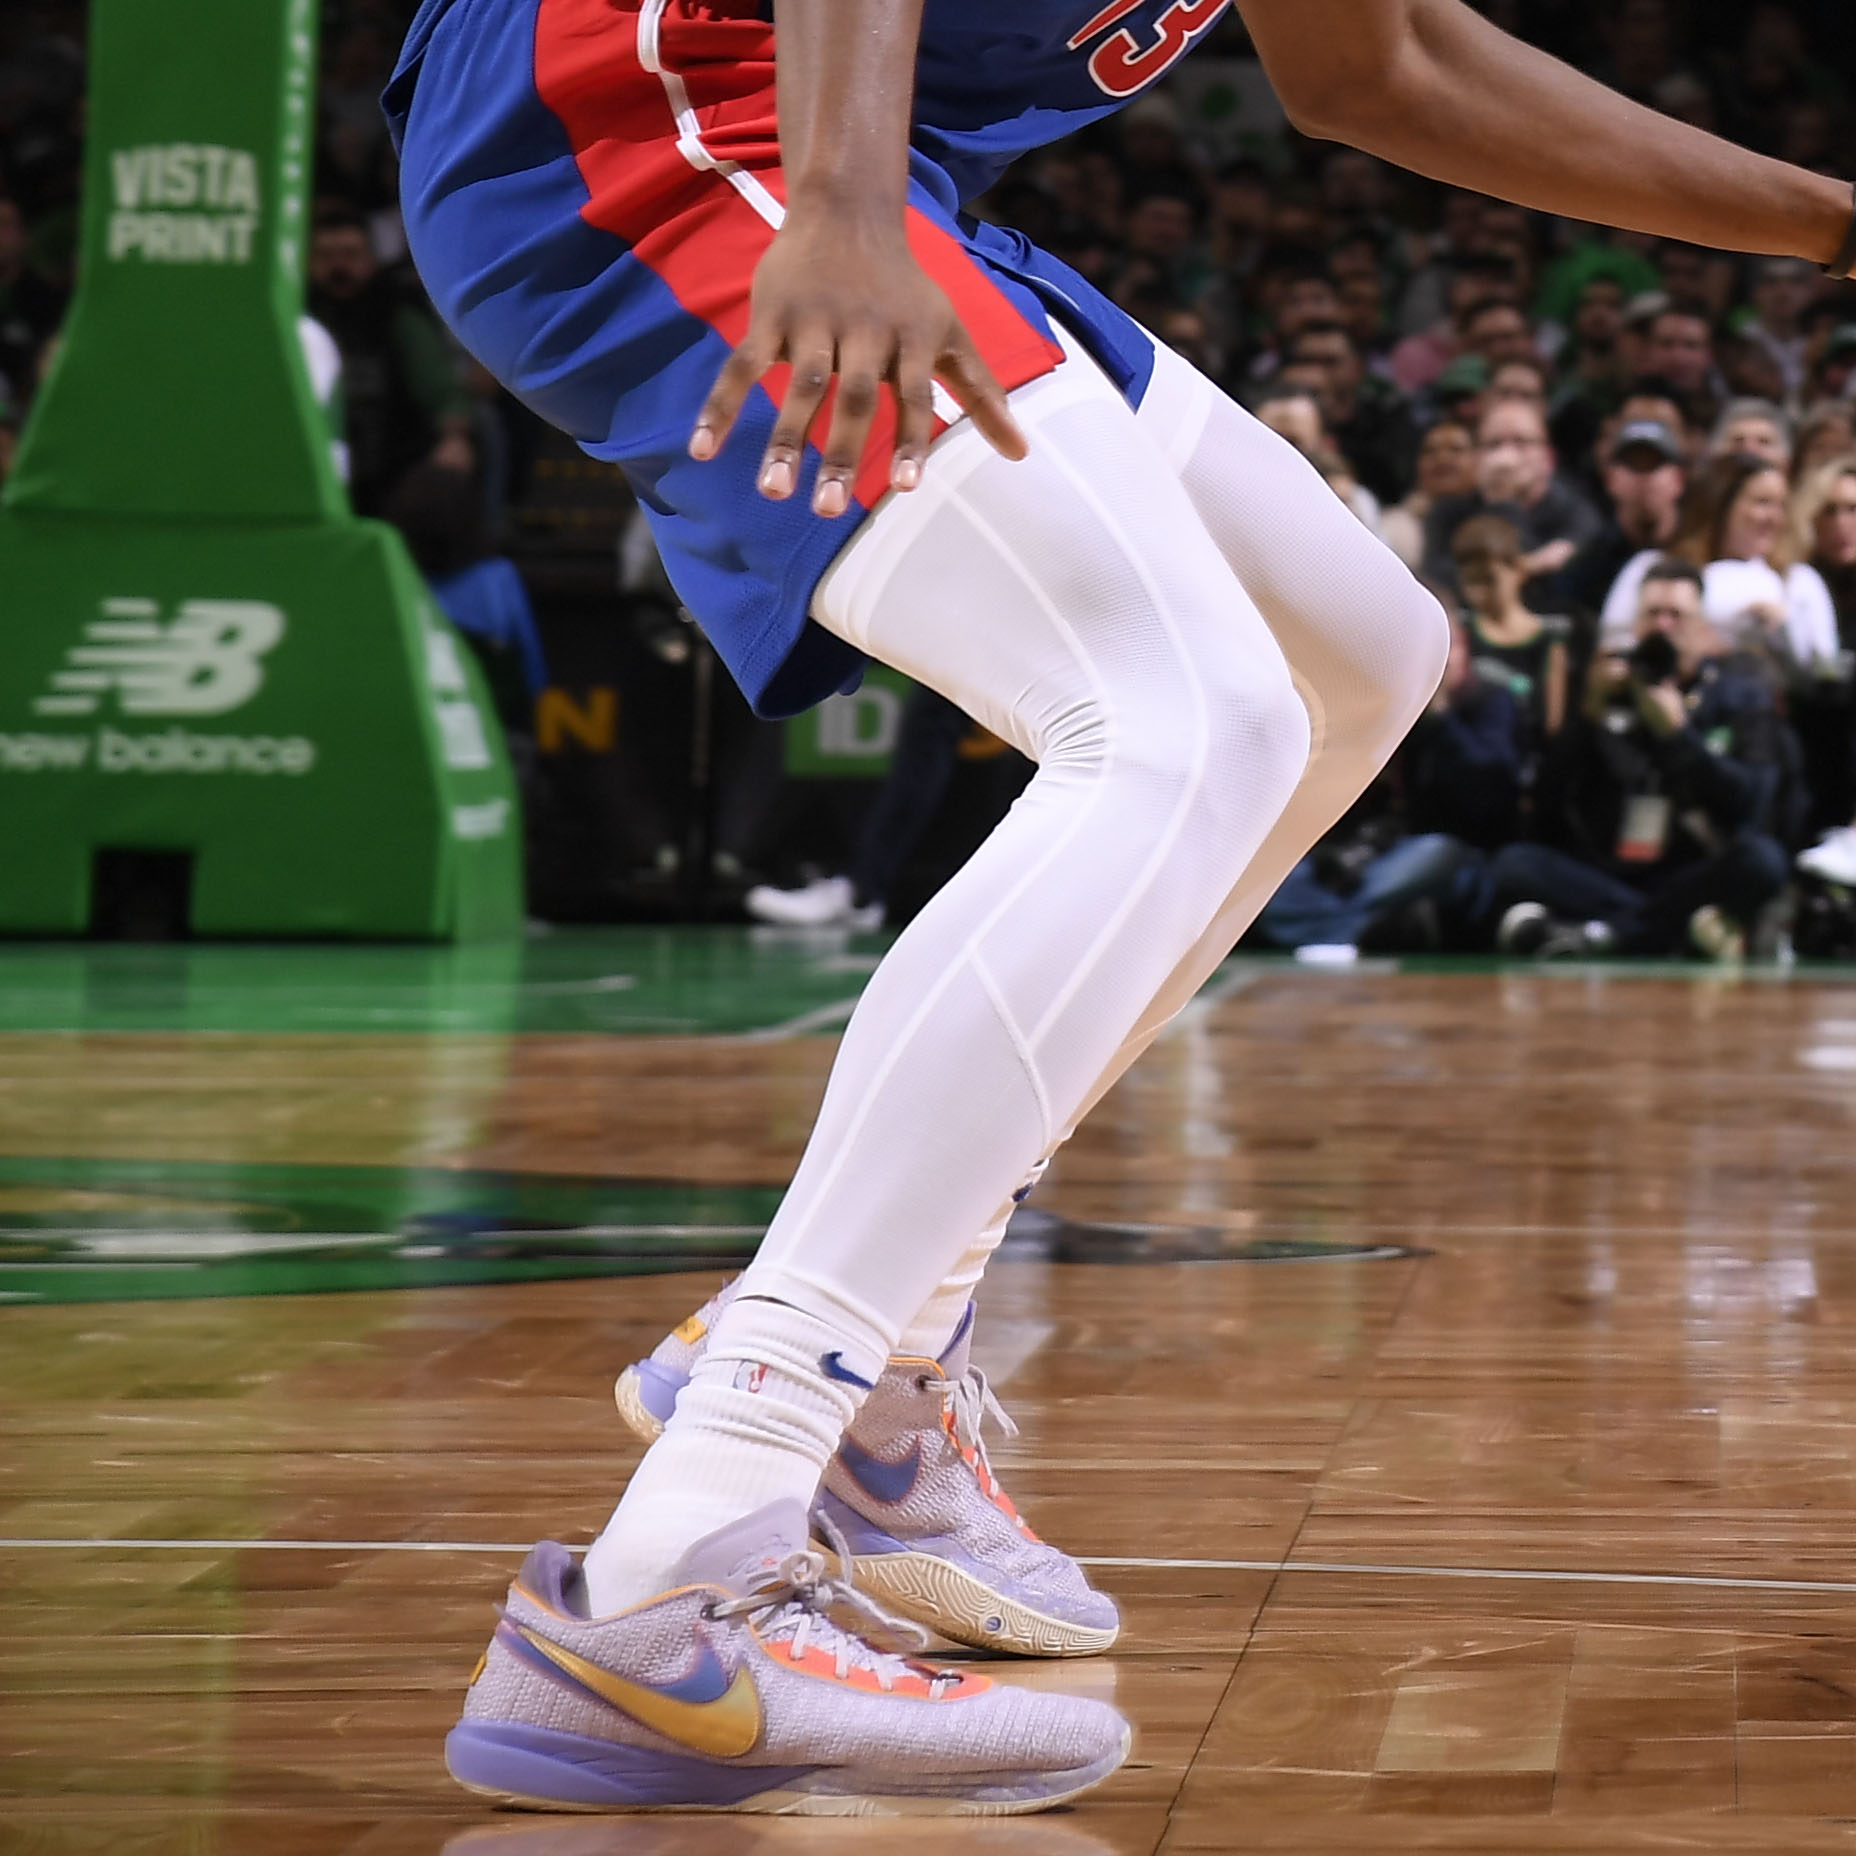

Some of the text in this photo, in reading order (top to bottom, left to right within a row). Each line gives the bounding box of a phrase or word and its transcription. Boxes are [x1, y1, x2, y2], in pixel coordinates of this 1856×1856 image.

[111, 144, 259, 211] VISTA
[107, 212, 259, 264] PRINT
[98, 723, 315, 775] balance
